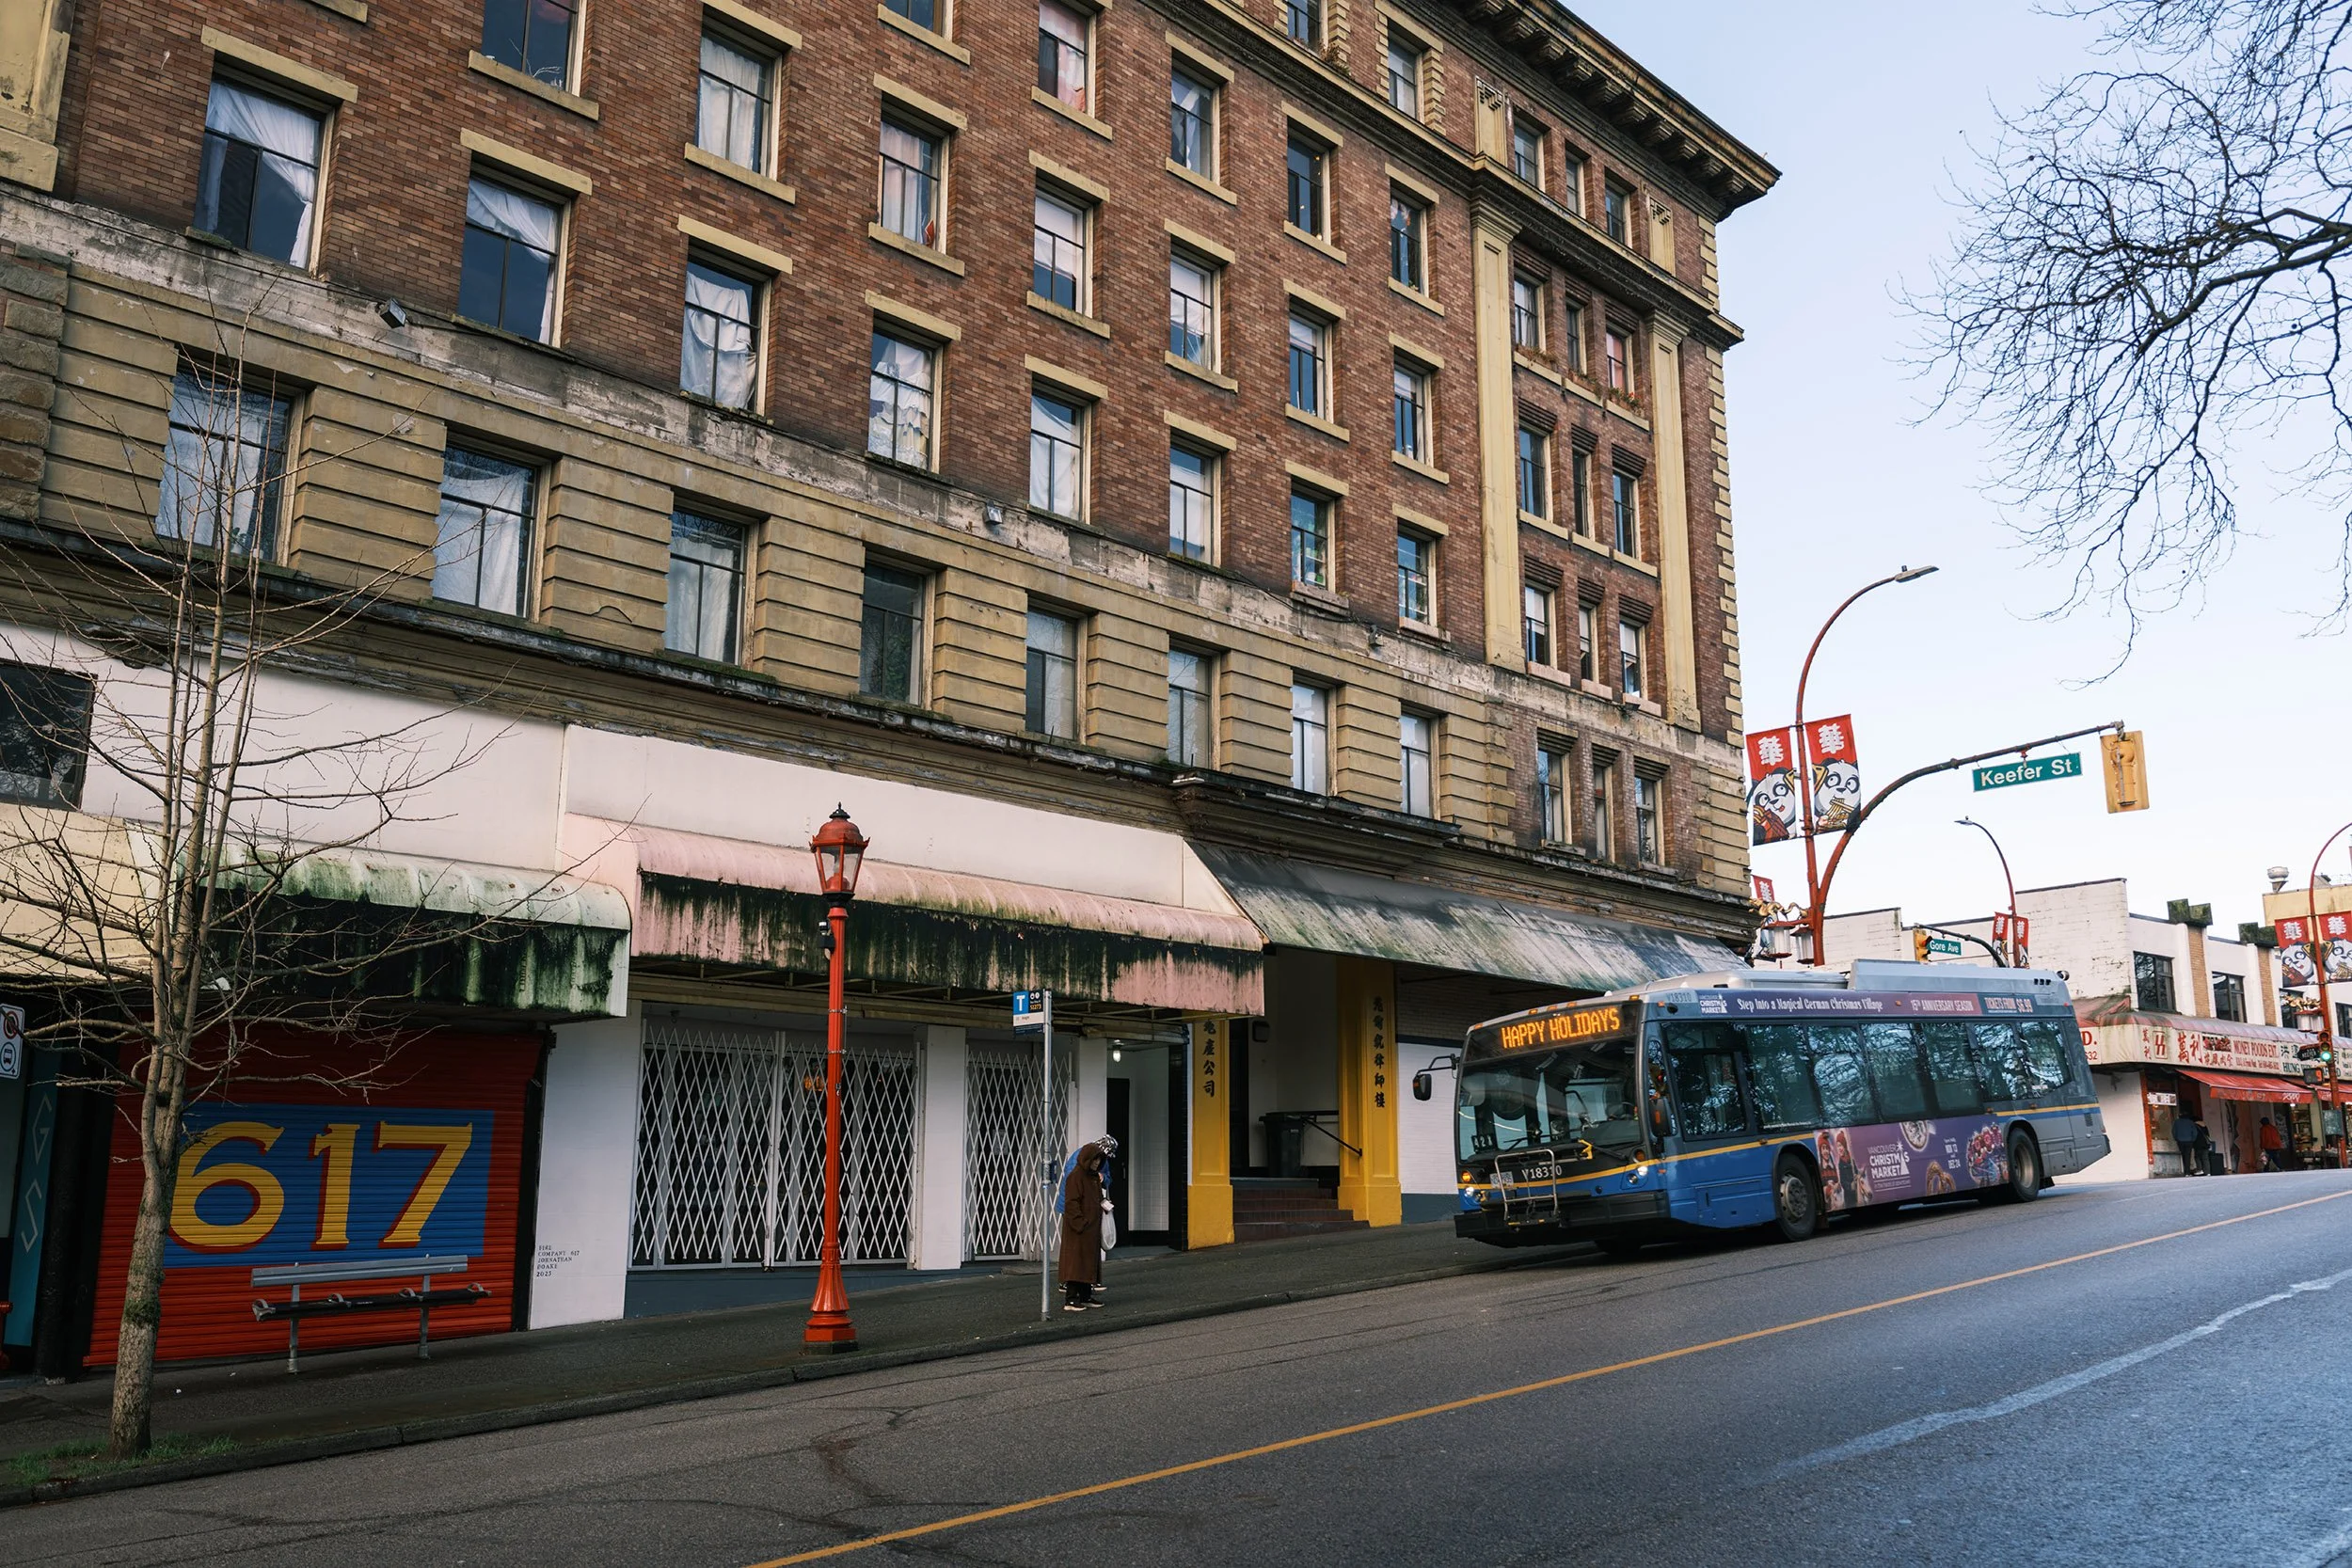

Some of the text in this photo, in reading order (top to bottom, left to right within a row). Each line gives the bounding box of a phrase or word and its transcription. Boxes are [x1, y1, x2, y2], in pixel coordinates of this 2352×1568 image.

[1818, 722, 1845, 754] 華
[1757, 736, 1784, 766] 華
[1980, 758, 2073, 787] Keefer St
[1929, 940, 1960, 953] Gore Ave
[1737, 997, 1883, 1013] Step Into a Magical German Christmas Village
[1954, 1000, 1975, 1011] SEASON
[1502, 1007, 1620, 1049] HAPPY HOLIDAYS
[1869, 1151, 1911, 1166] CHRISTMAS
[1871, 1164, 1901, 1180] MARKET
[167, 1120, 473, 1254] 617
